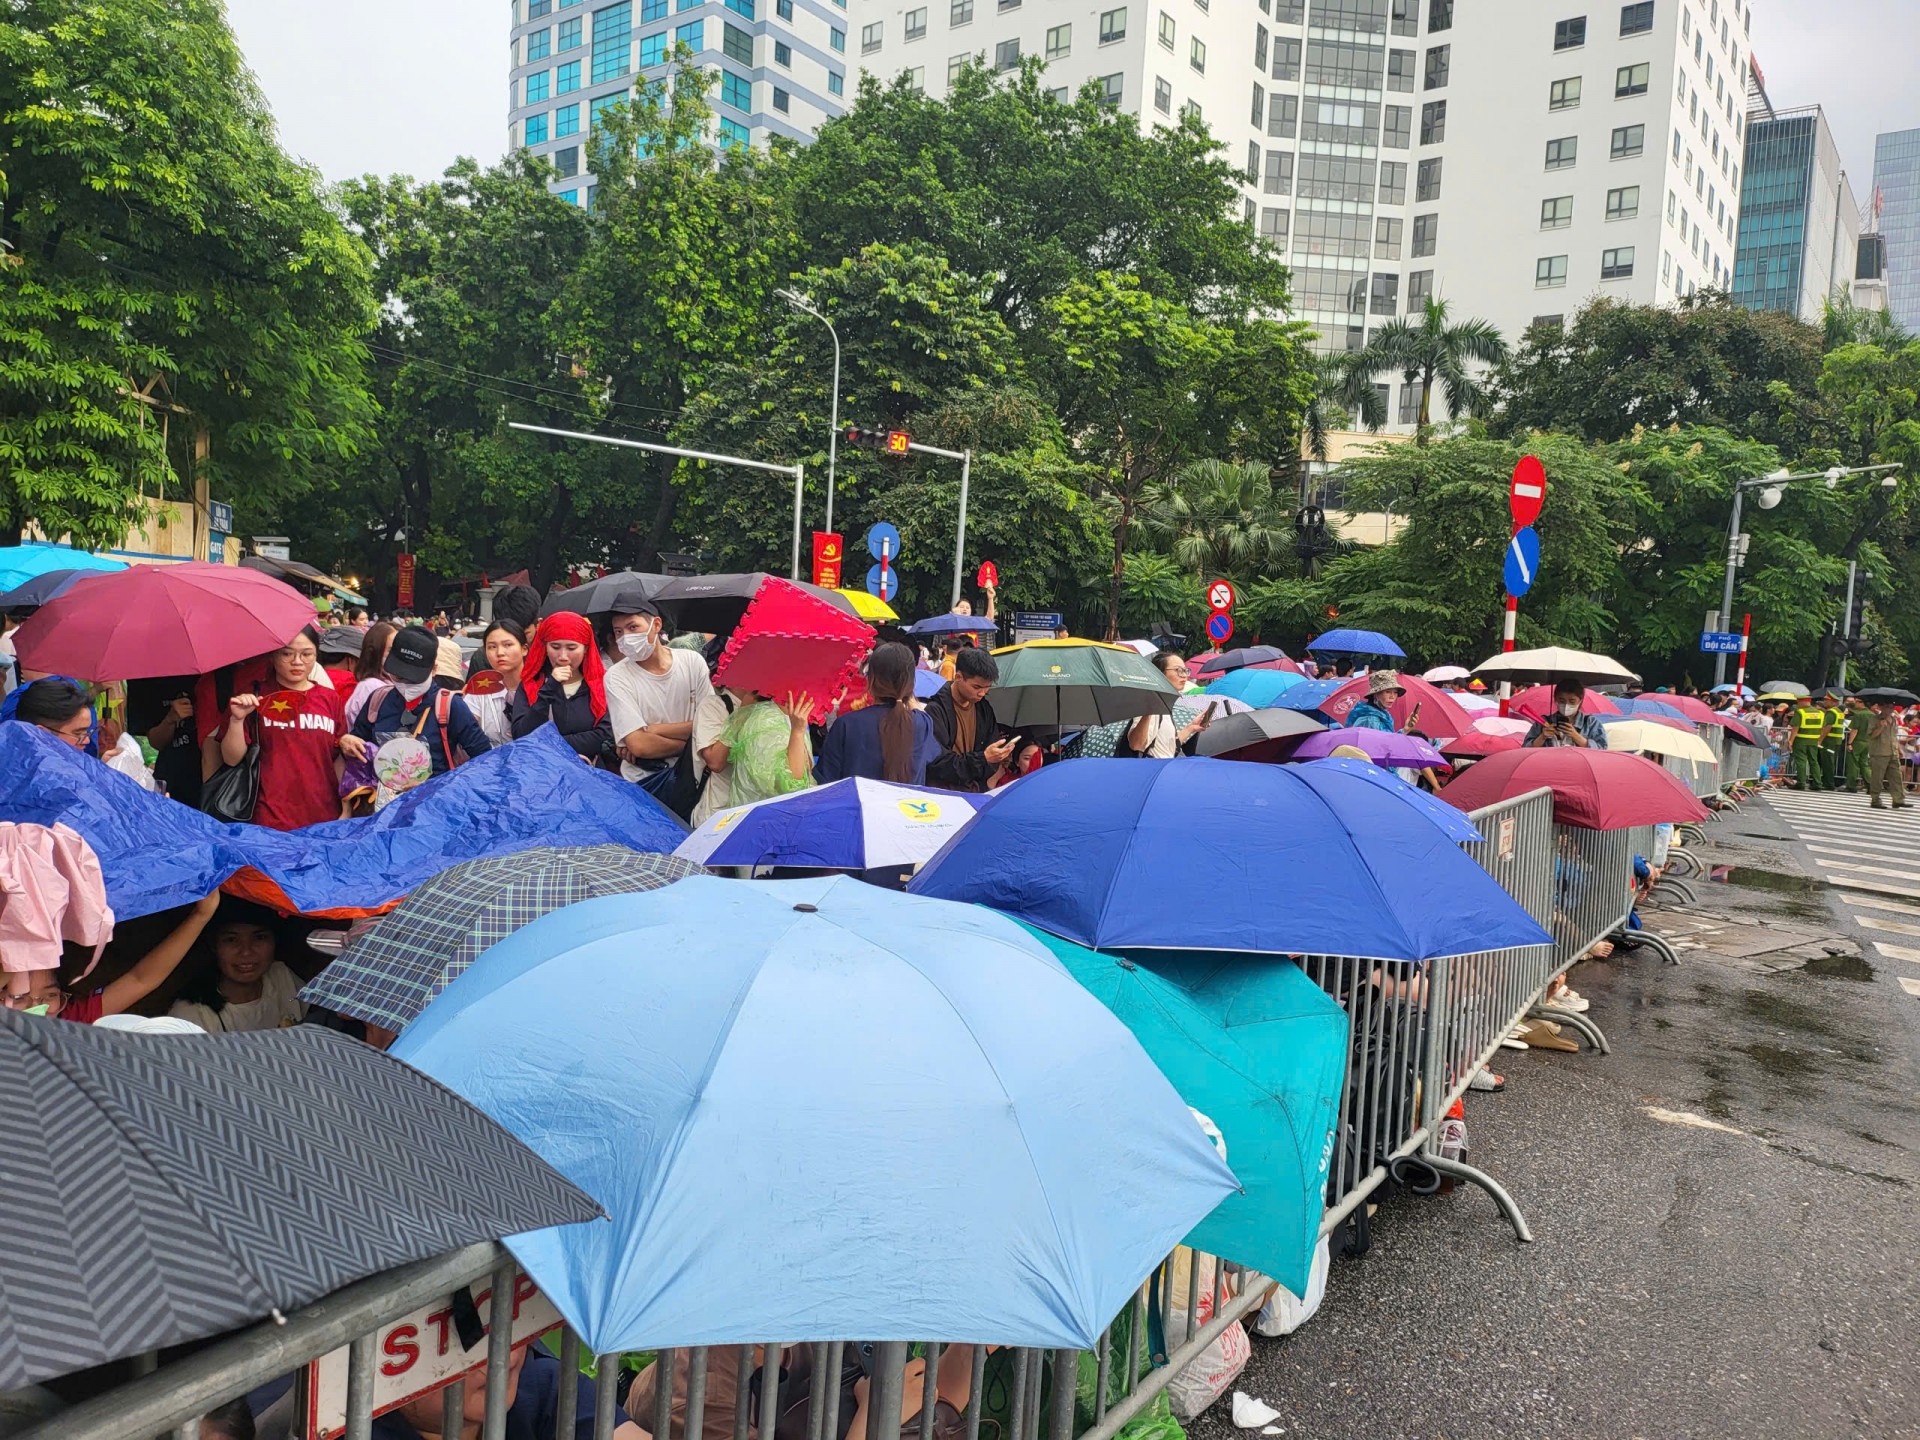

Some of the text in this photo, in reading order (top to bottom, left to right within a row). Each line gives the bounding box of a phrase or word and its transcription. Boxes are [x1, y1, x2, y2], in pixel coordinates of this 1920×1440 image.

[1704, 641, 1738, 651] ĐỘI CẤN
[299, 713, 335, 735] NAM
